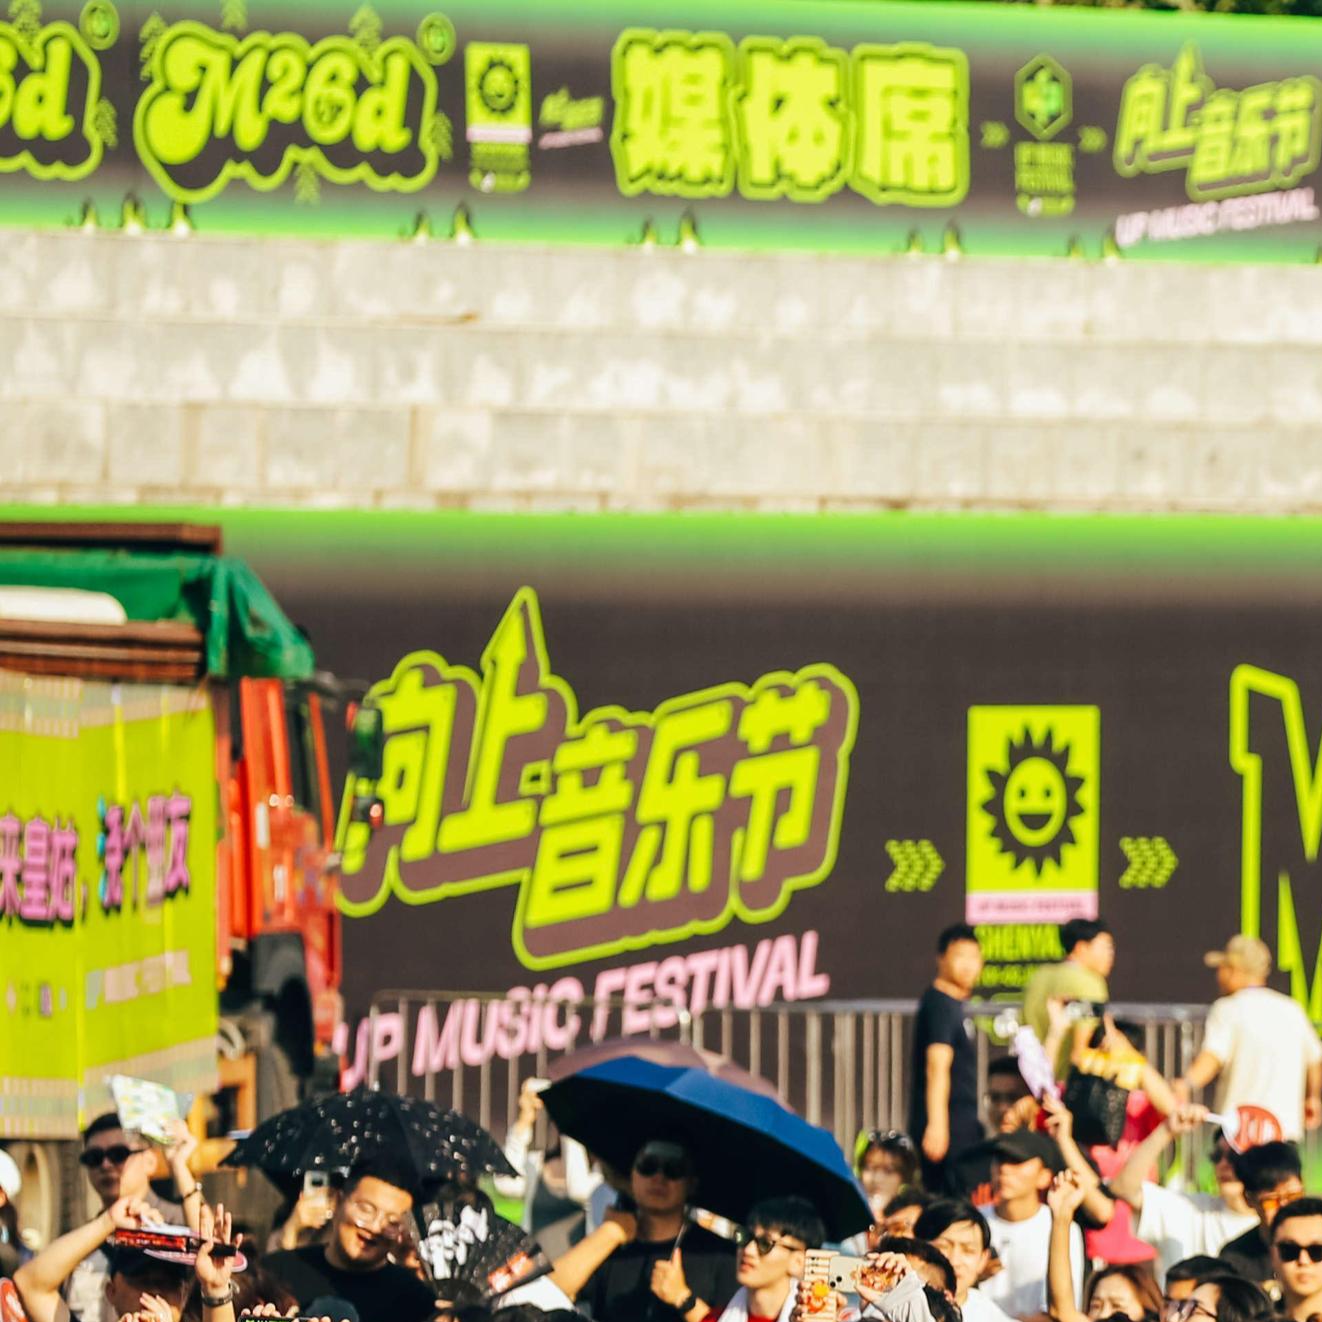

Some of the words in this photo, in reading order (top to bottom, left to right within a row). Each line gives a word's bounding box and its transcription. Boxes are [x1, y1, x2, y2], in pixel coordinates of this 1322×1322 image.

[622, 40, 963, 195] 媒体席
[338, 592, 842, 938] 向上音乐节
[412, 976, 585, 1076] MUSIC
[590, 930, 831, 1042] FESTIVAL
